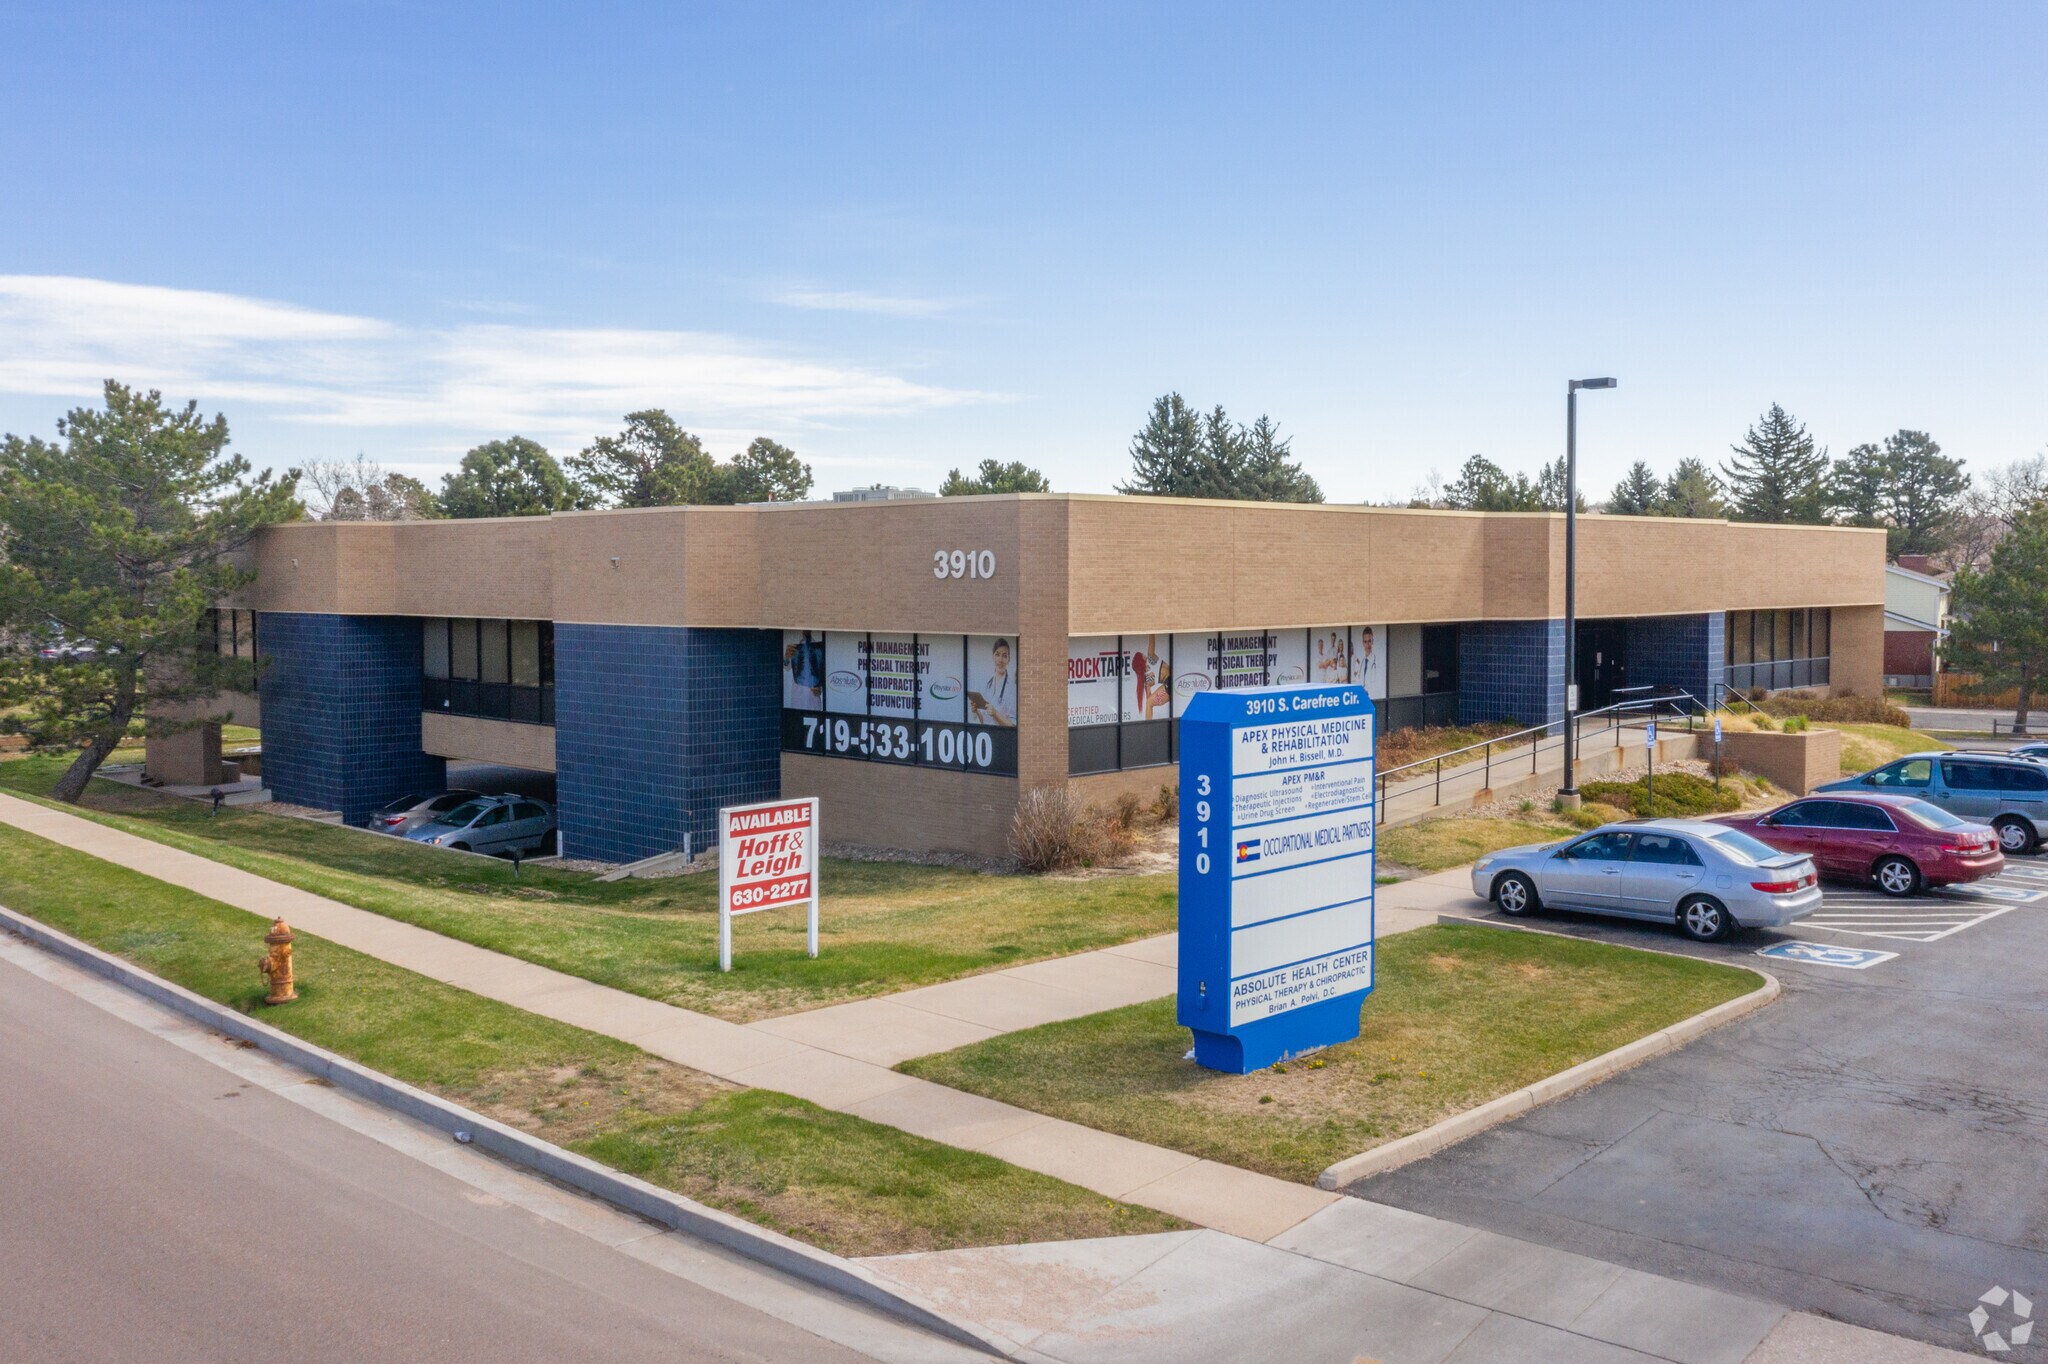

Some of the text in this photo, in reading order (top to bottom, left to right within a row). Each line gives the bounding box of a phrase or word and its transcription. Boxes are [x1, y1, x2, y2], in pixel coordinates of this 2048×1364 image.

[934, 550, 996, 580] 3910
[858, 641, 874, 653] PAN
[1208, 636, 1277, 651] PAN MANAGEMNT
[858, 659, 893, 672] PHSICAL
[1208, 656, 1244, 670] PHSICAL
[866, 677, 922, 692] HIROPRACTC
[1215, 672, 1270, 689] CHIROPRACTC
[866, 694, 922, 709] CUPUNCTUE
[1247, 692, 1359, 715] 3910 S. Carefree Cir.
[1242, 719, 1366, 743] APEX PHYSICAL MEDICINE
[803, 717, 992, 767] 719-533-1000
[1262, 733, 1349, 754] & REHABILITATION
[1270, 748, 1344, 768] John H. Bissell, M.D.
[1282, 771, 1325, 785] APEX PM&R
[1315, 776, 1365, 789] Interventional Pain
[1236, 787, 1303, 803] Diagnostic Ultrasound
[1315, 786, 1364, 799] Electrodiagnostics
[1236, 796, 1302, 812] Therapeutic Injections
[1241, 806, 1295, 820] Urine Drug Screen
[730, 807, 810, 831] AVAILABLE
[1197, 775, 1211, 874] 3910
[1264, 821, 1370, 856] OCCUPATIONAL MEDICAL PARTNERS
[737, 852, 802, 878] Leigh
[733, 879, 808, 906] 630-2277
[1234, 951, 1367, 997] ABSOLUTE HEALTH CENTER
[1236, 994, 1272, 1010] PHYSICAL
[1275, 983, 1307, 998] THERAPY
[1316, 966, 1365, 987] CHIROPRACTIC
[1269, 1003, 1287, 1013] Brian
[1324, 987, 1336, 997] D.C.
